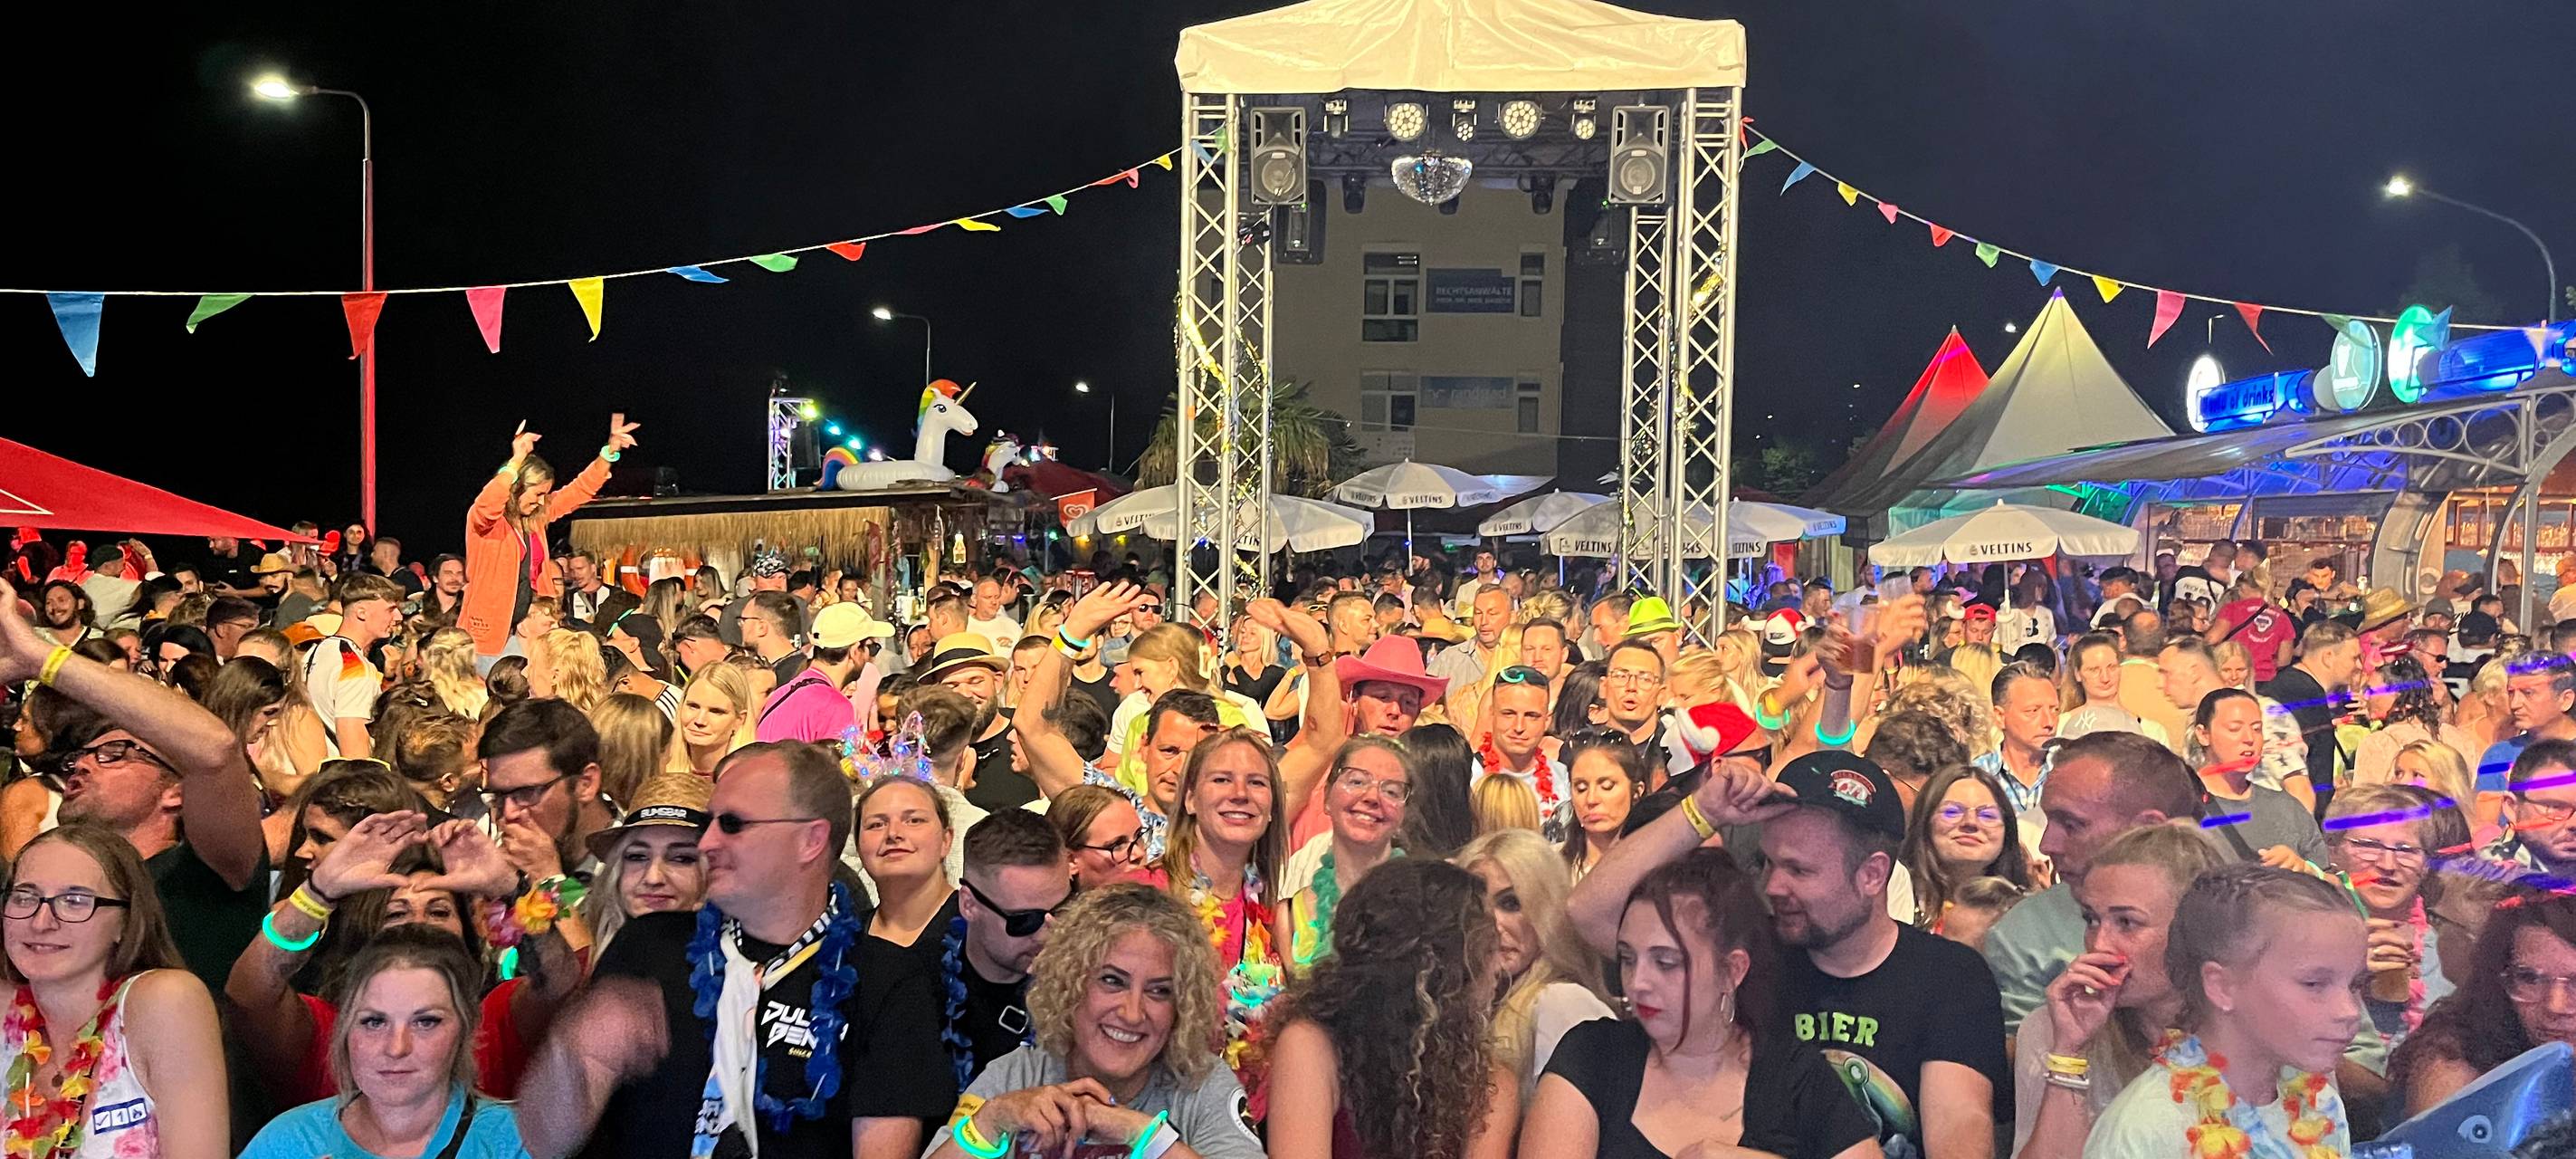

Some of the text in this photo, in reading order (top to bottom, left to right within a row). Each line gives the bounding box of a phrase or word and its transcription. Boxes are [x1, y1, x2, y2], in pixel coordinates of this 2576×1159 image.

[1409, 495, 1443, 504] VELTINS
[1498, 522, 1522, 532] VELTINS
[1575, 540, 1612, 553] VELTINS
[1980, 541, 2033, 555] VELTINS
[1794, 1011, 1880, 1048] BIER
